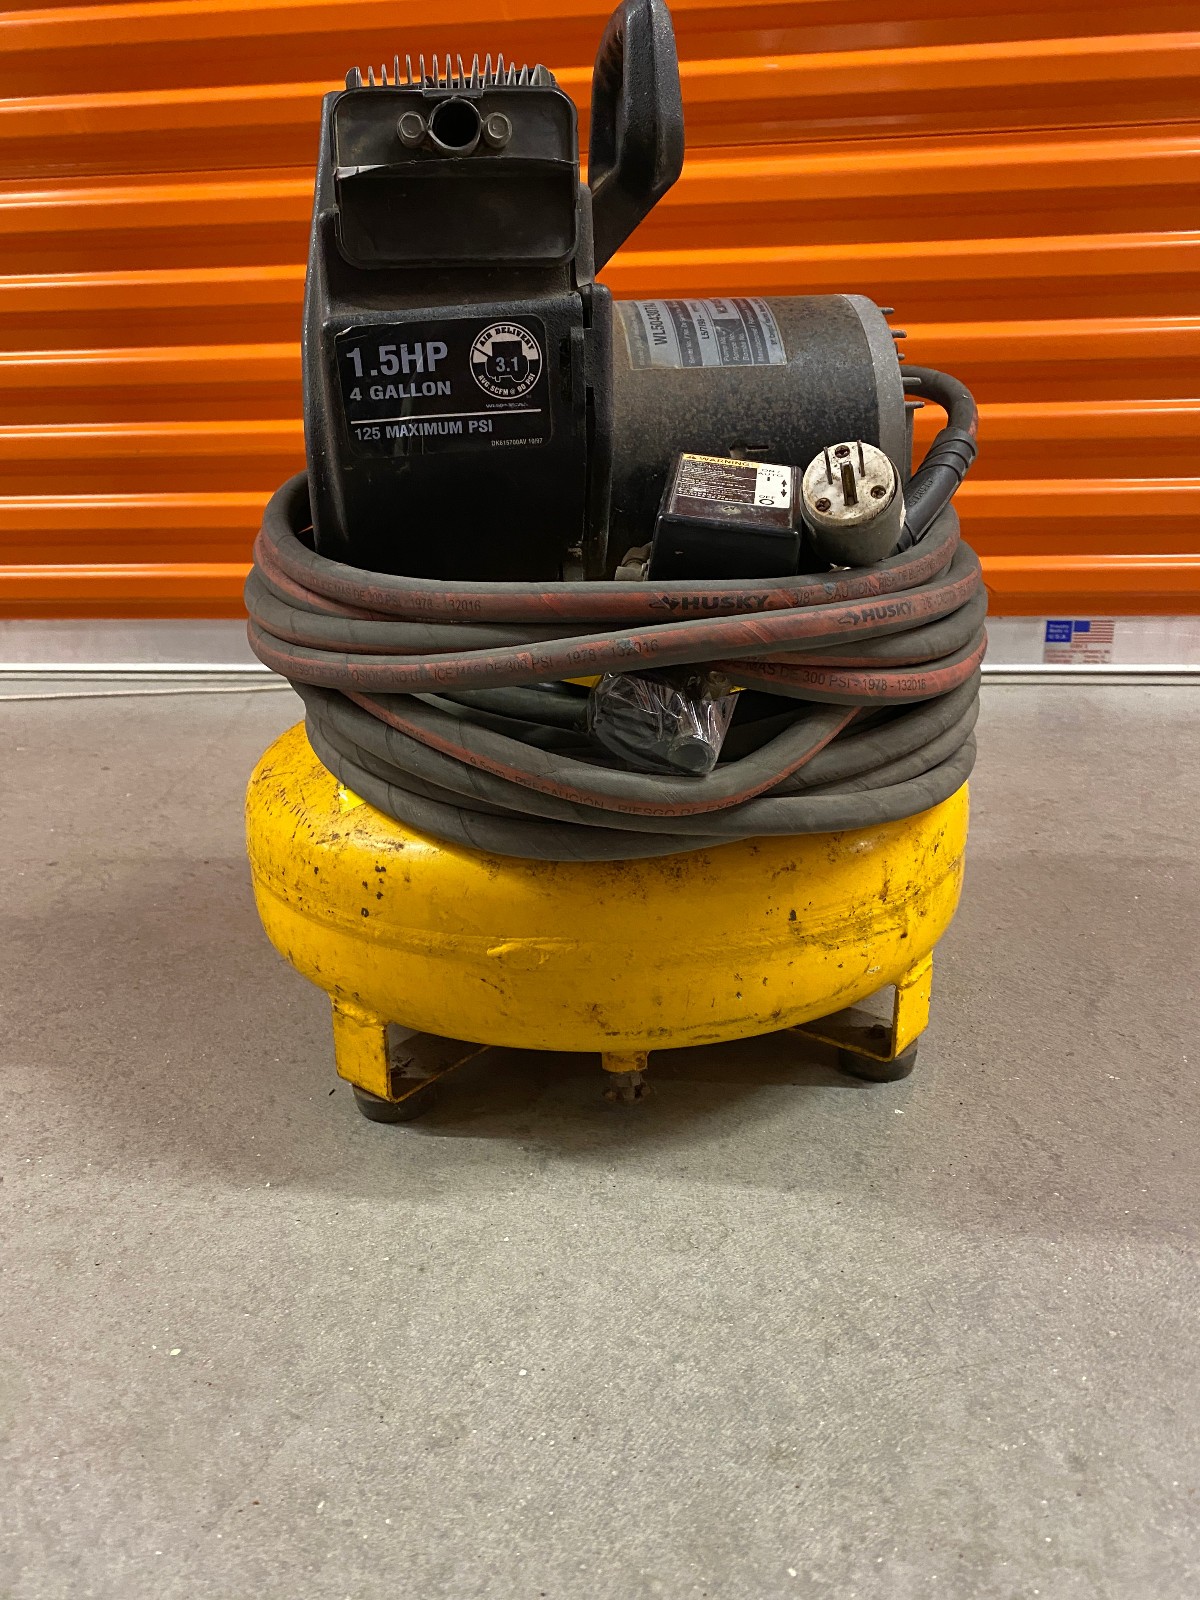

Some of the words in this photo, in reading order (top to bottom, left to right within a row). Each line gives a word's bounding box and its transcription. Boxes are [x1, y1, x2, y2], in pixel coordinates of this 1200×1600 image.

[479, 332, 493, 347] AIR
[495, 326, 535, 350] DELIVERY
[346, 341, 448, 377] 1.5HP
[495, 356, 519, 372] 3.1
[350, 387, 363, 401] 4
[370, 381, 451, 400] GALLON
[490, 385, 509, 396] SCFM
[525, 372, 536, 385] PSI
[354, 426, 381, 441] 125
[386, 420, 463, 438] MAXIMUM
[469, 419, 493, 433] PSI
[682, 594, 769, 610] HUSKY
[861, 602, 912, 623] HUSKY
[803, 670, 826, 685] 300
[829, 674, 851, 688] PSI
[862, 678, 887, 691] 1978
[897, 678, 927, 691] 132016
